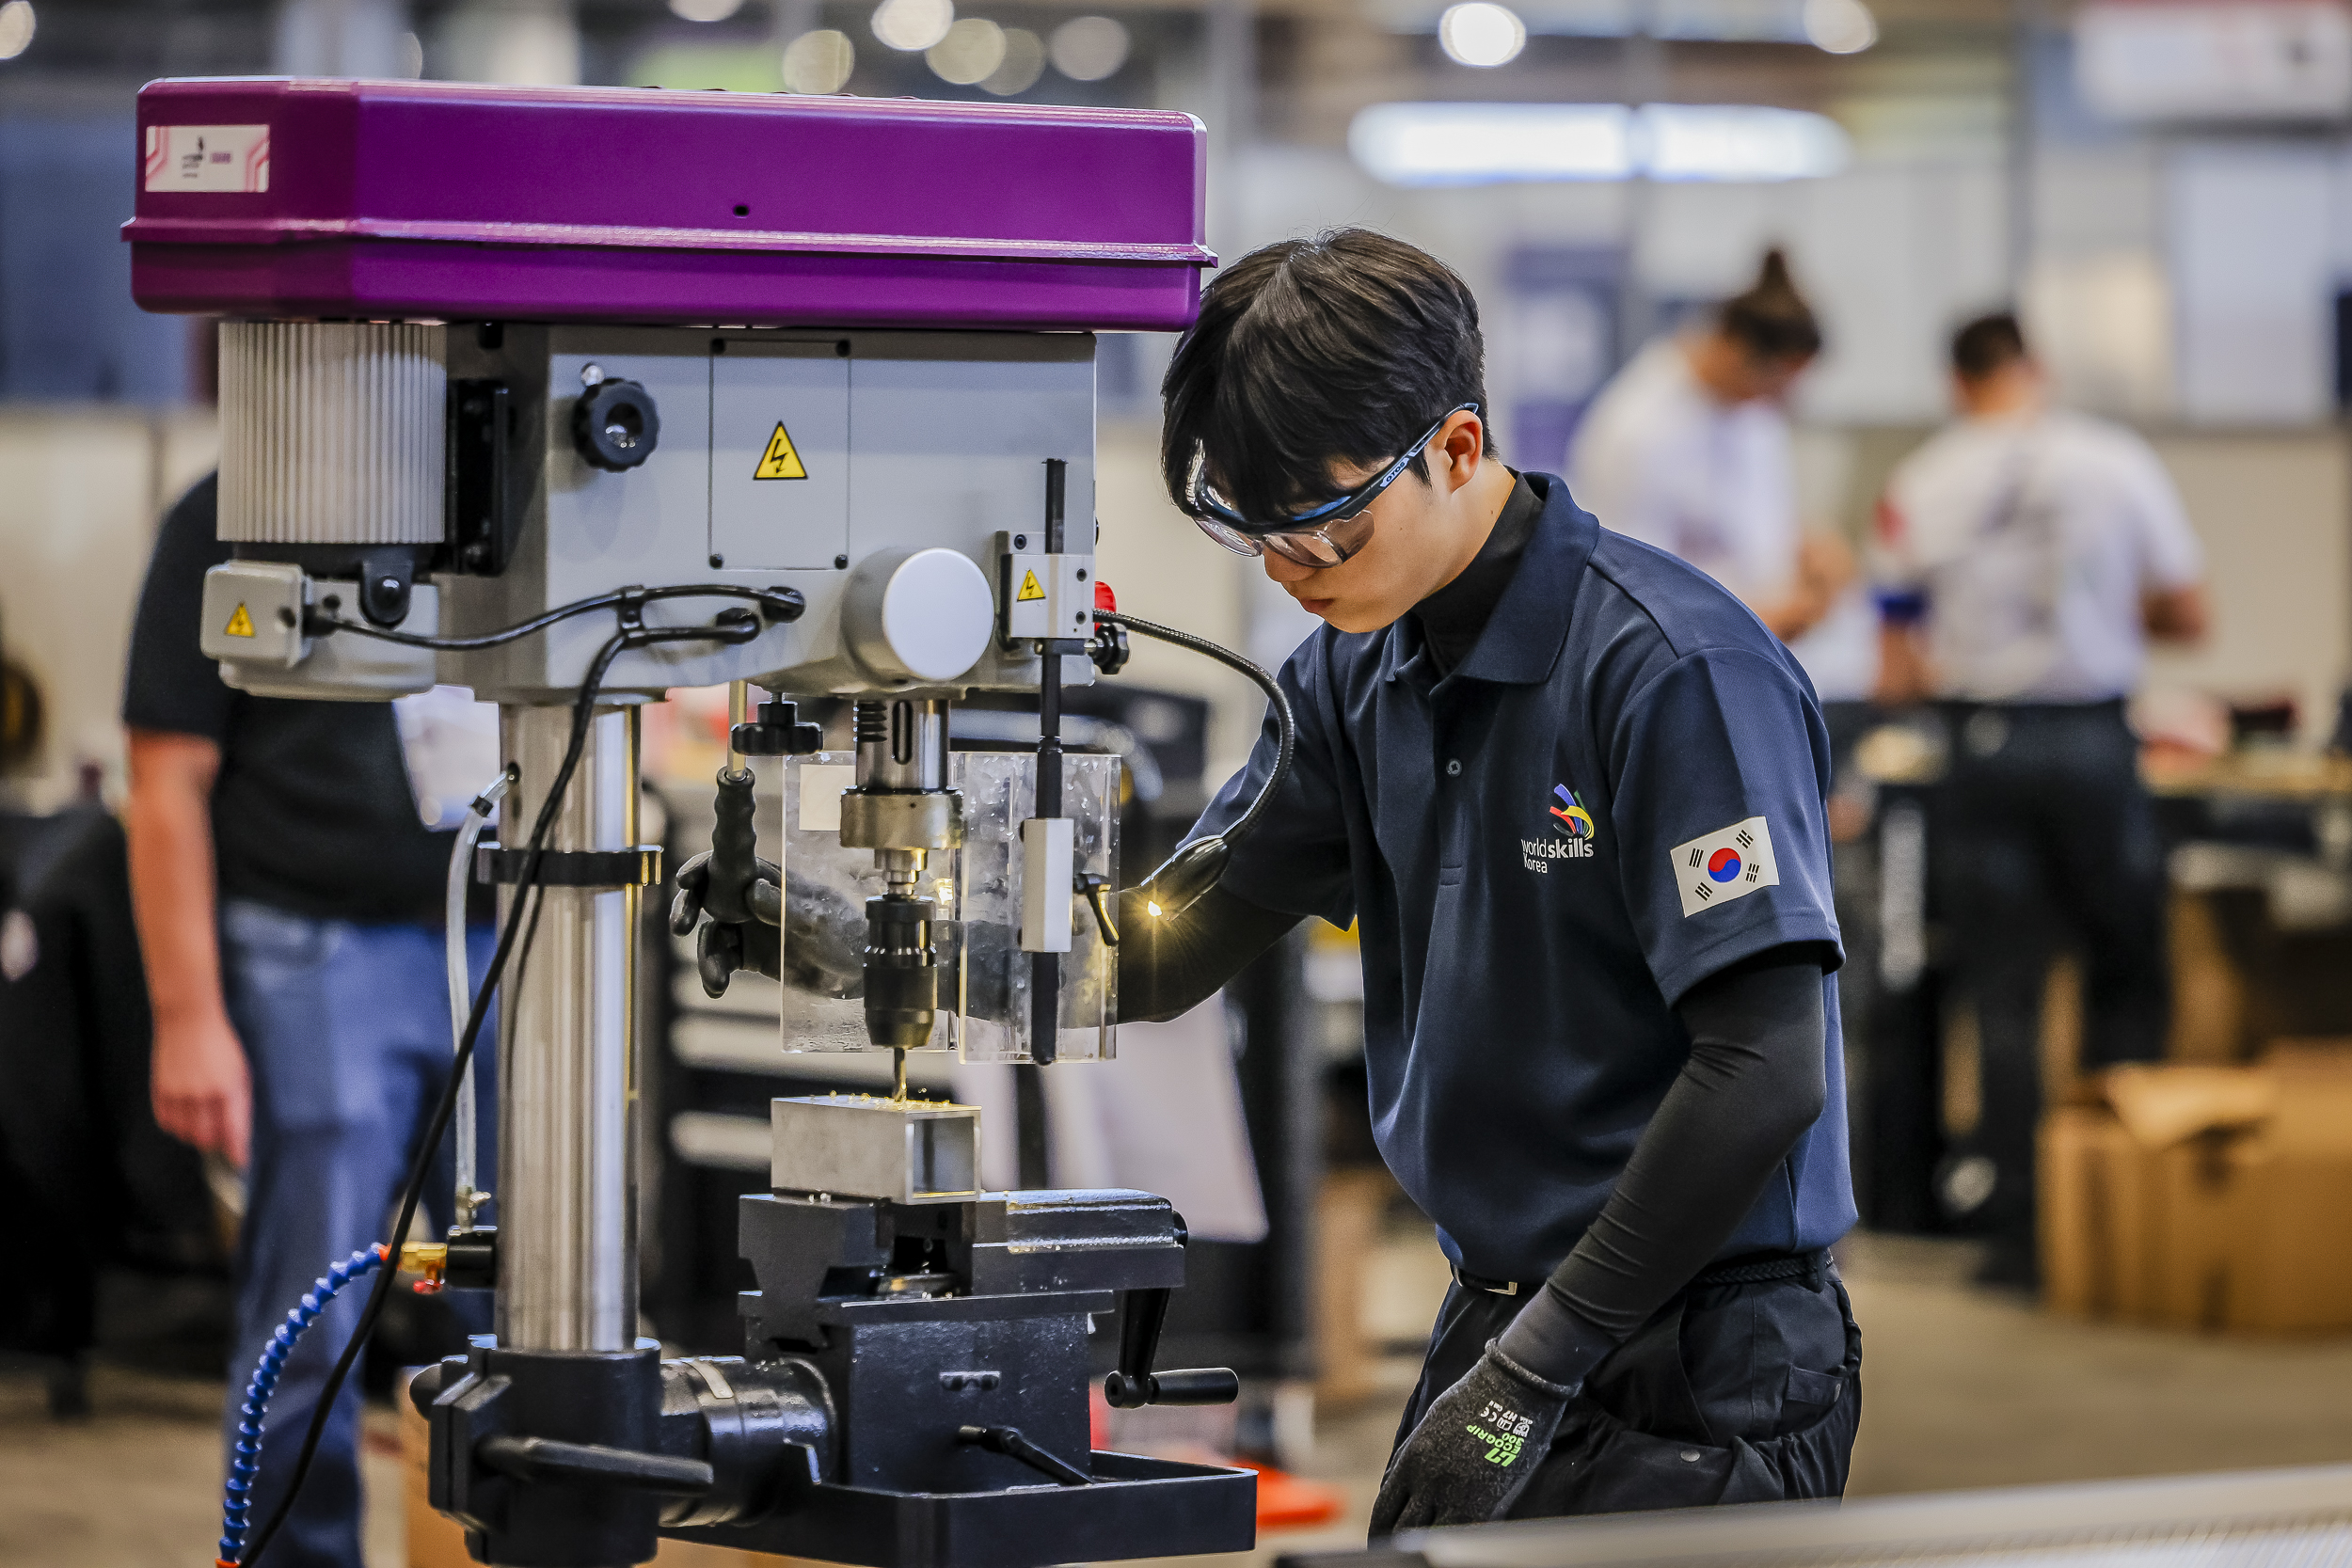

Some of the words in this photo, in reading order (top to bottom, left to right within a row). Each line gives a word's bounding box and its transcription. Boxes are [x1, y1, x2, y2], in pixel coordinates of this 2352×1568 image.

[1386, 461, 1406, 482] OTOS
[1520, 837, 1594, 859] worldskills
[1523, 851, 1548, 874] Korea
[1467, 1424, 1522, 1455] ECOGRIP
[1502, 1432, 1525, 1447] 300
